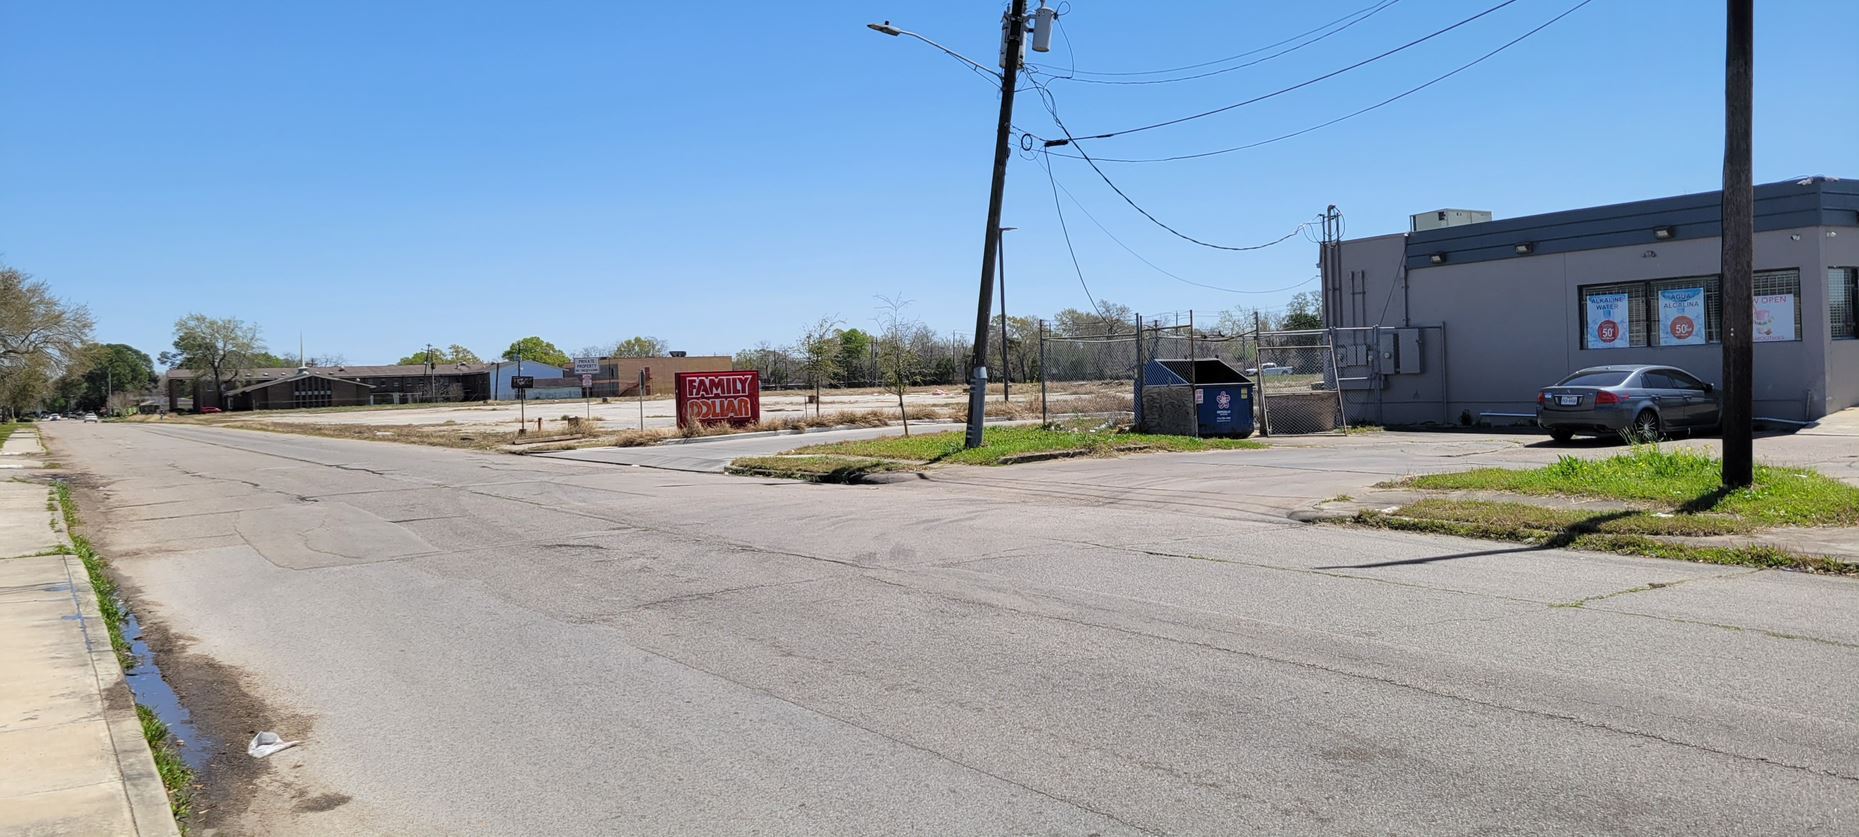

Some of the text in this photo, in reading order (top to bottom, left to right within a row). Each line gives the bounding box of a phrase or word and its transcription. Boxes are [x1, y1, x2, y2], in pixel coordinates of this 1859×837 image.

[1591, 296, 1624, 304] ALKALINE
[1761, 295, 1787, 304] OPEN
[1663, 301, 1699, 309] ALCALINA
[686, 375, 752, 398] FAMILY
[688, 397, 751, 419] DOLLAR
